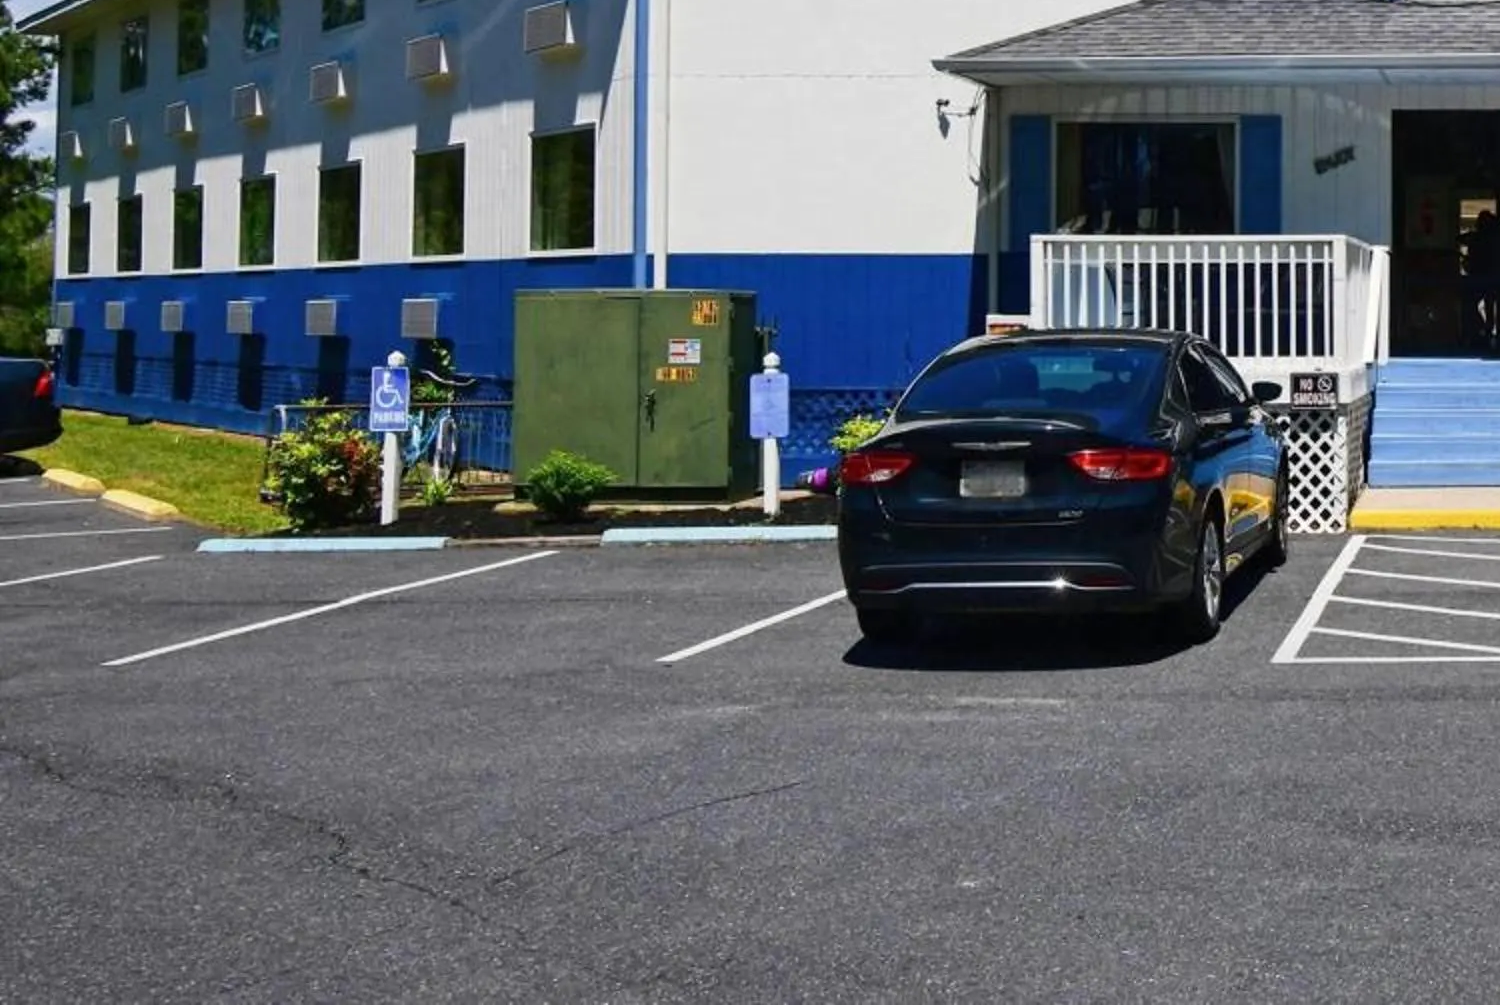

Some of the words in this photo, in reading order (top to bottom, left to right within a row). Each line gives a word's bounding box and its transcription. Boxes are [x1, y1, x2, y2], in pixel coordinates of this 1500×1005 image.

[1299, 378, 1313, 391] NO
[1293, 392, 1336, 405] SMOKING
[373, 410, 405, 424] PARKING
